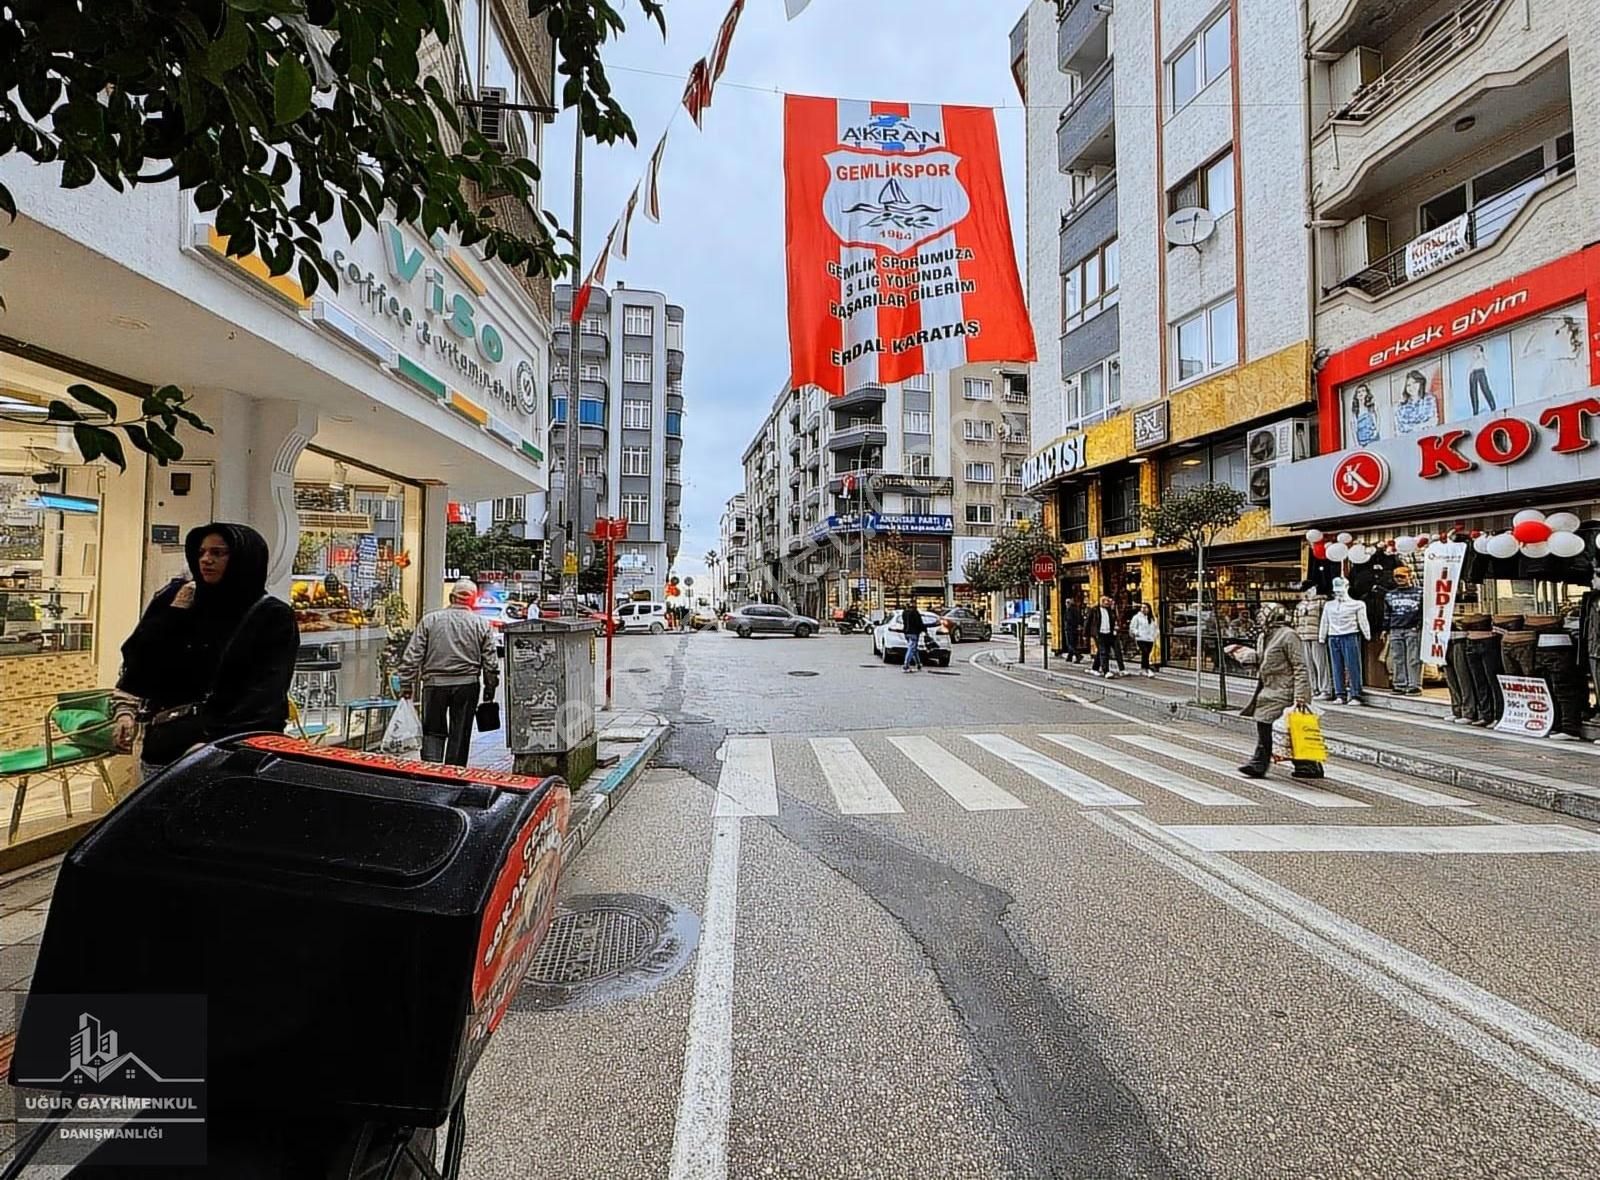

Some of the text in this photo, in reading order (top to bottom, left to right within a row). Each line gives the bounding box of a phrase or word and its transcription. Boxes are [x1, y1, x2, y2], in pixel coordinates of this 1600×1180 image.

[842, 127, 940, 144] AKRAN
[836, 160, 951, 181] GEMLİKSPOR
[828, 249, 973, 281] GEMLİK SPORUMUZA
[858, 273, 880, 292] LİG
[886, 266, 953, 288] YOLUNDA
[830, 280, 975, 320] BAŞARILAR DİLERİM
[831, 321, 980, 366] ERDAL KARATAŞ
[1369, 289, 1529, 367] erkek giyim
[1418, 398, 1600, 479] KOT
[1034, 563, 1054, 573] DUR
